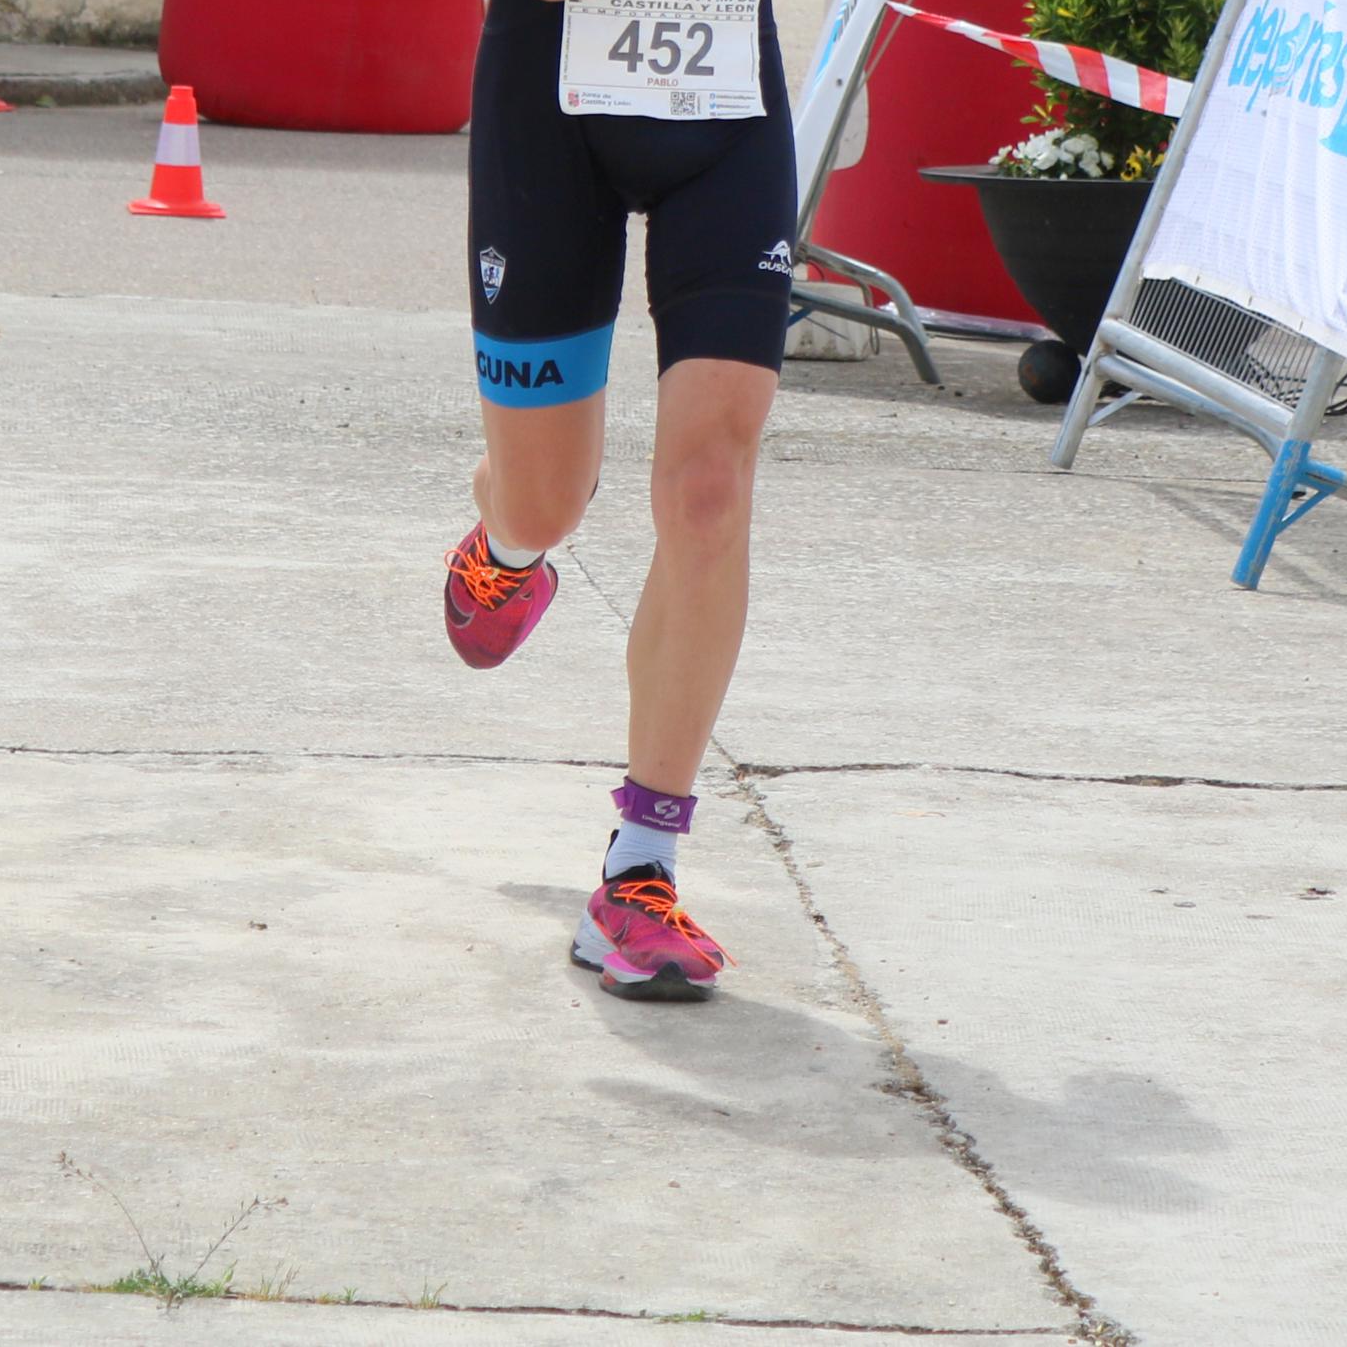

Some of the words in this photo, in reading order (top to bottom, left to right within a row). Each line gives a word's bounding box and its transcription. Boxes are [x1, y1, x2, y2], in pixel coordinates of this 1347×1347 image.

[610, 0, 694, 12] CASTILLA
[702, 4, 710, 13] Y
[607, 19, 714, 77] 452
[646, 77, 679, 88] PABLO
